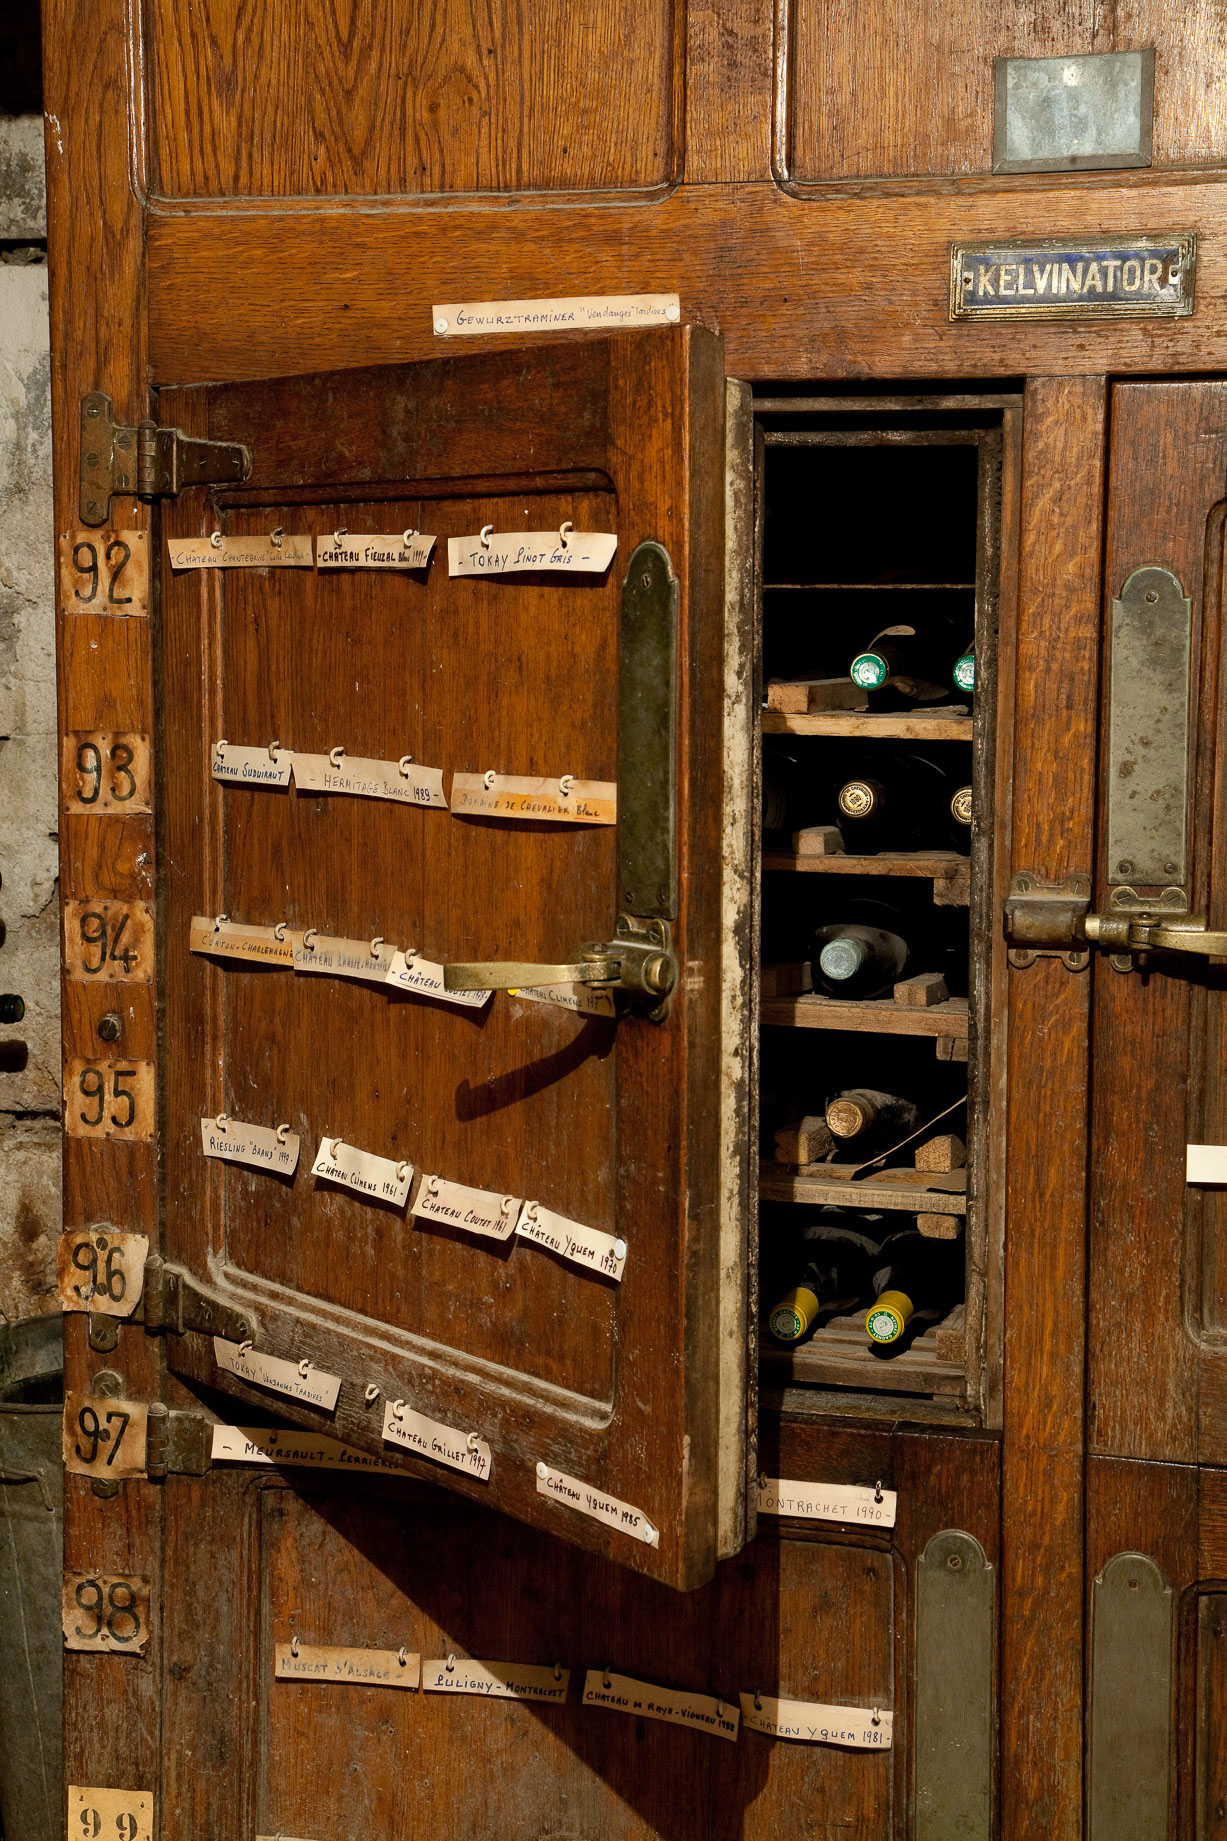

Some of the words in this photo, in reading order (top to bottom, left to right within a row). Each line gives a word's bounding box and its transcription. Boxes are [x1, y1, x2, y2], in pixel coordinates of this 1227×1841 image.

[977, 258, 1163, 296] KELVINATOR
[72, 540, 133, 605] 92
[469, 551, 509, 571] TOKAY
[75, 742, 137, 804] 93
[412, 786, 431, 802] 1989
[79, 911, 138, 974] 94
[79, 1067, 137, 1129] 95
[72, 1241, 127, 1303] 96
[599, 1254, 618, 1274] 1970
[229, 1357, 256, 1381] TOKAY
[75, 1406, 131, 1467] 97
[620, 1510, 641, 1528] 1985
[855, 1506, 882, 1520] 1990
[75, 1581, 141, 1644] 98
[862, 1730, 883, 1744] 1981
[79, 1807, 138, 1841] 99
